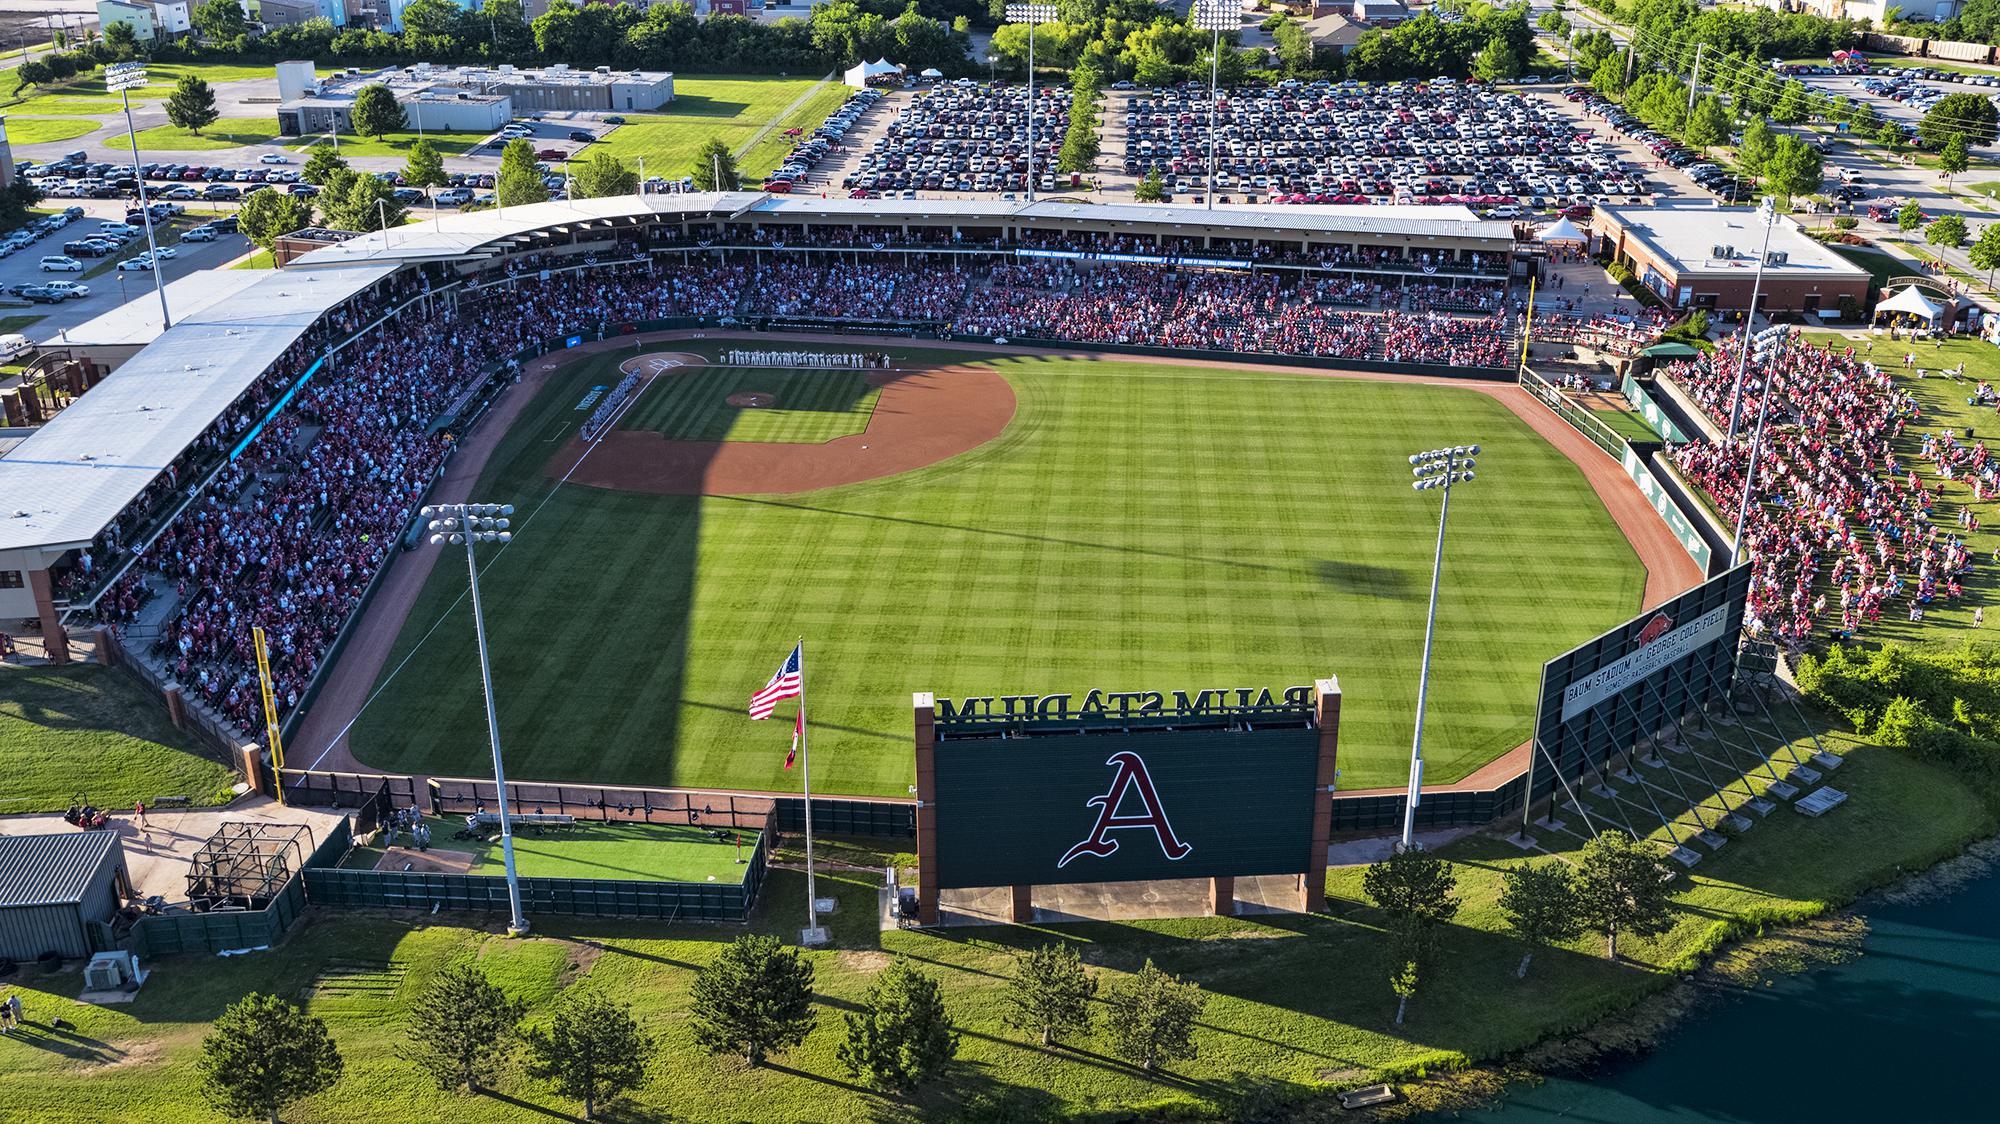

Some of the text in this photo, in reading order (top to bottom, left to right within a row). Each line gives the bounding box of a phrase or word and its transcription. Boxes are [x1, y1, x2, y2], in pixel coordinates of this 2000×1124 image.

[1567, 608, 1725, 702] BAUM STADIUM AT GEORGE COLE FIELD
[1057, 750, 1193, 868] A
